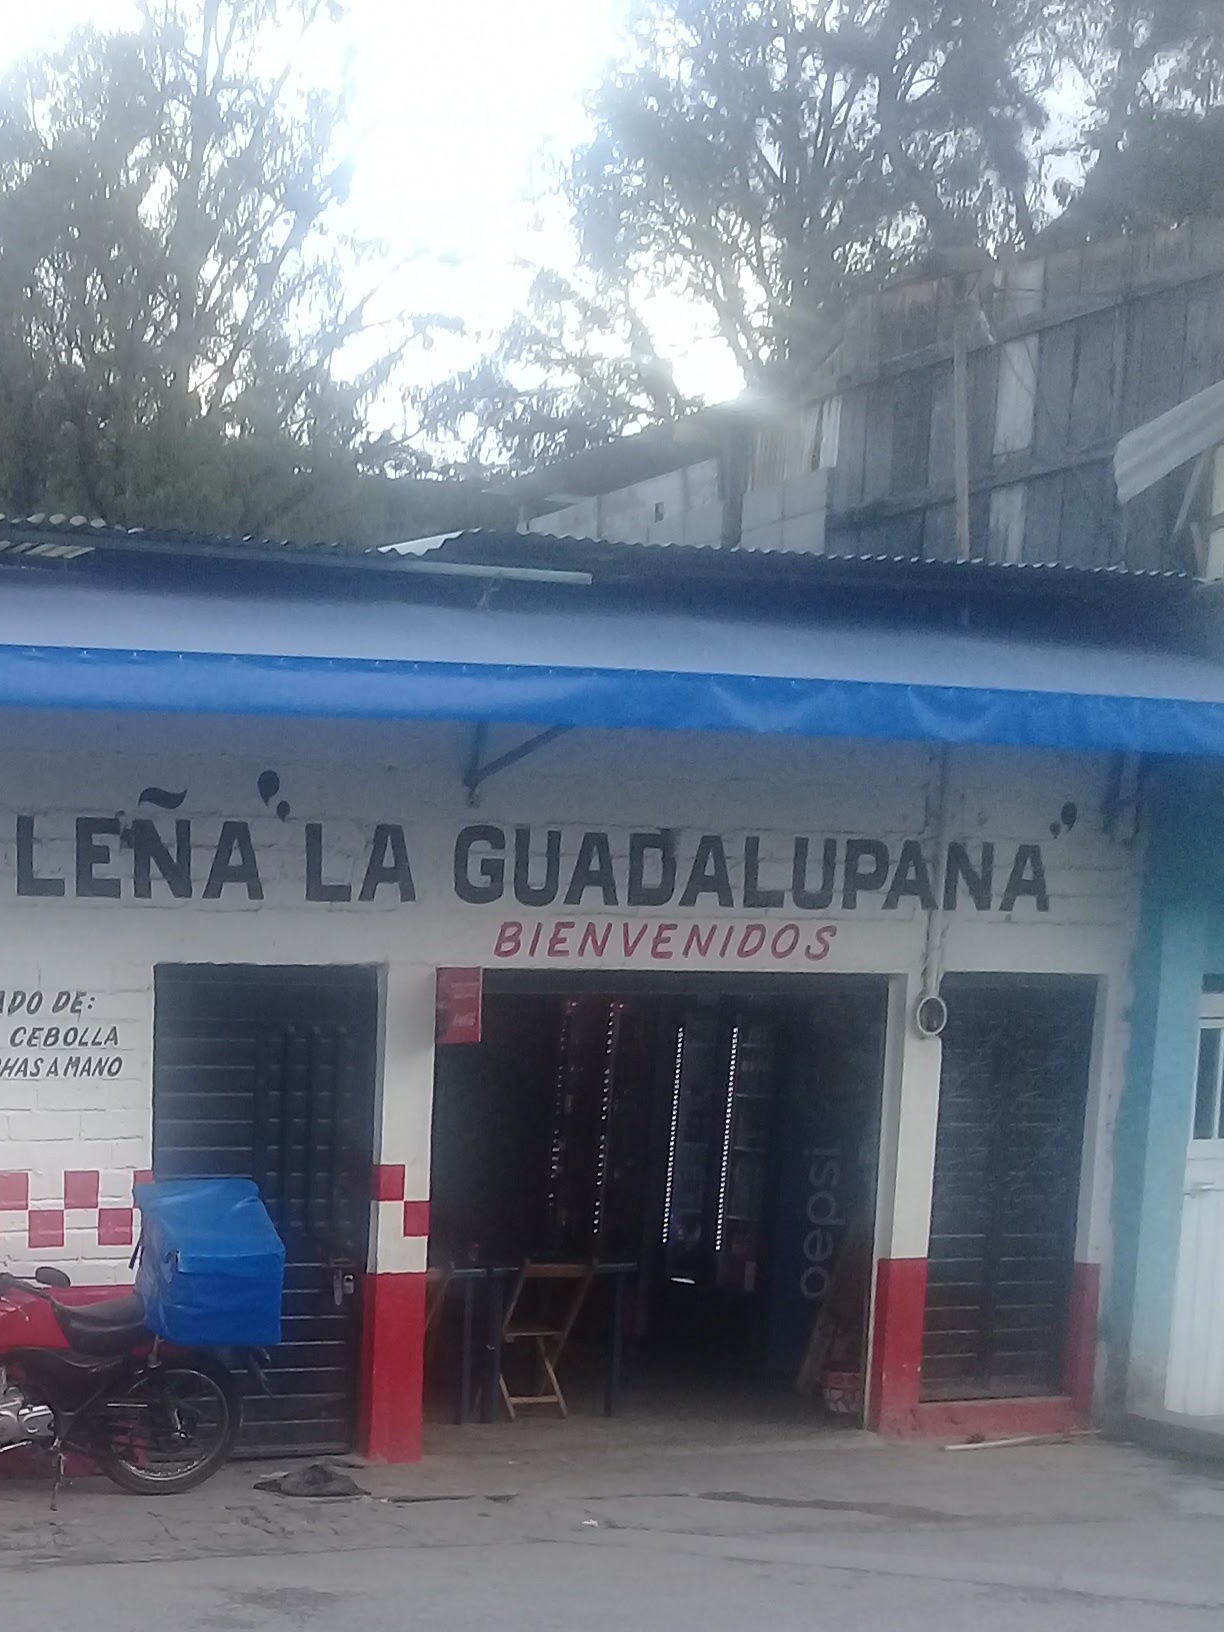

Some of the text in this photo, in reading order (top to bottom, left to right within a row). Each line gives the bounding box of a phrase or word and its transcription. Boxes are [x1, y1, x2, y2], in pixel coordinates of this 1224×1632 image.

[17, 786, 264, 900] LEÑA
[304, 822, 417, 903] LA
[452, 823, 1051, 913] GUADALUPANA
[493, 921, 838, 959] BIENVENIDOS
[51, 990, 96, 1015] DE:
[9, 1026, 120, 1047] CEBOLLA
